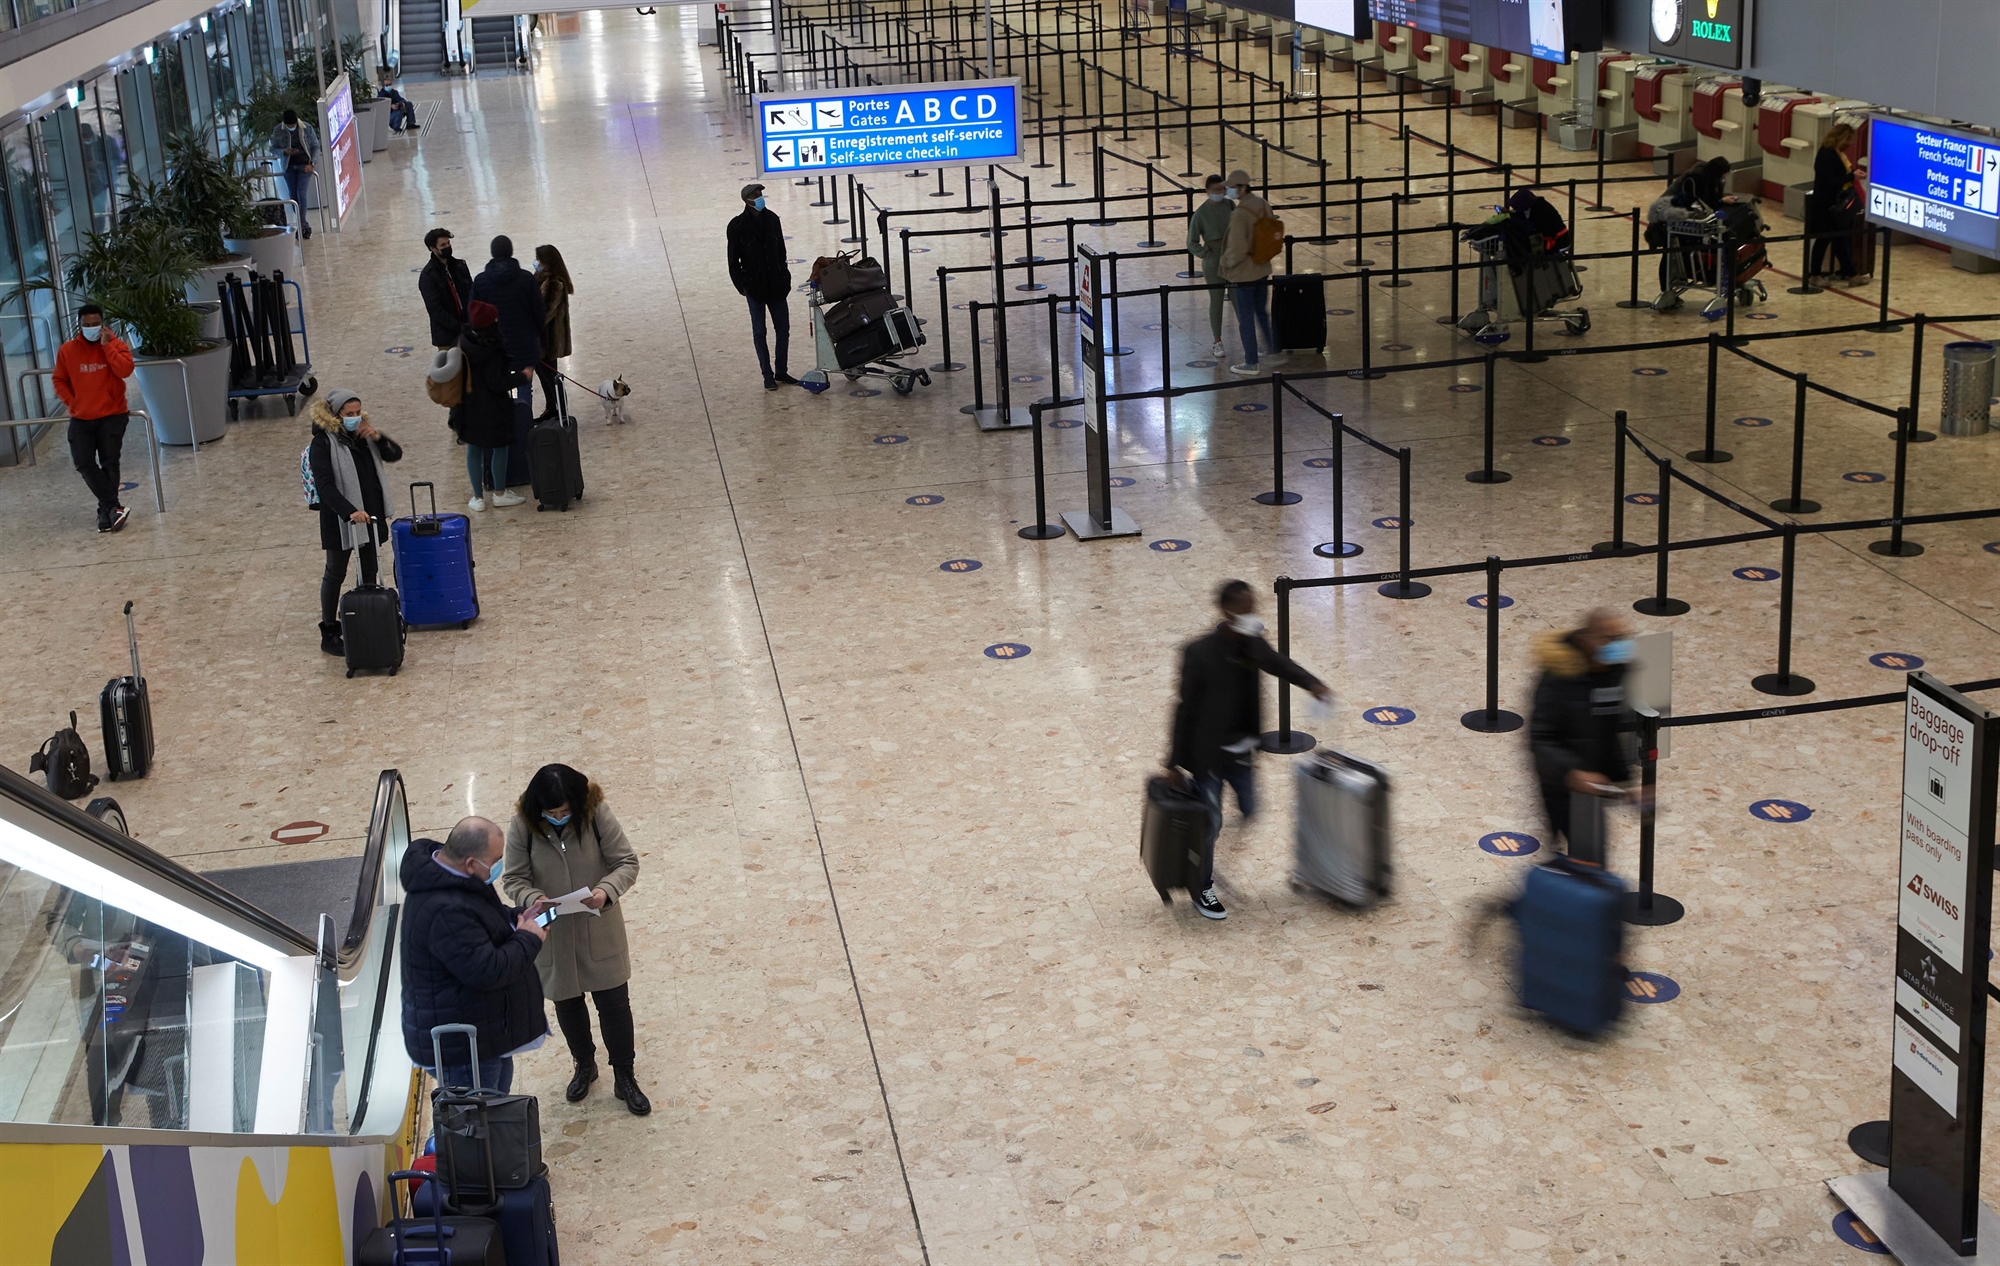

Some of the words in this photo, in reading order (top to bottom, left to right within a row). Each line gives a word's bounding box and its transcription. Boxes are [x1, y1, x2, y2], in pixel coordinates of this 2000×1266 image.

[1692, 20, 1731, 42] ROLEX
[849, 100, 890, 112] Portes
[895, 100, 915, 124] A
[924, 98, 941, 122] B
[950, 96, 968, 121] C
[977, 94, 997, 119] D
[850, 115, 887, 127] Gates
[830, 132, 928, 150] Enregistrement
[931, 128, 1003, 143] self-service
[1916, 132, 1942, 148] Secteur
[1943, 138, 1967, 154] France
[830, 148, 903, 164] Self-service
[906, 146, 958, 159] check-in
[1918, 147, 1942, 162] French
[1943, 153, 1966, 168] Sector
[1927, 169, 1949, 184] Portes
[1928, 184, 1948, 199] Gates
[1953, 178, 1962, 201] F
[1924, 202, 1955, 220] Toilettes
[1924, 216, 1947, 233] Toilets
[1911, 695, 1964, 744] Baggage
[1909, 722, 1961, 766] drop-off
[1906, 811, 1925, 833] With
[1926, 824, 1961, 861] boarding
[1906, 829, 1924, 848] pass
[1925, 843, 1942, 862] only
[1923, 884, 1959, 921] SWISS
[1902, 968, 1920, 988] STAR
[1920, 984, 1955, 1016] ALLIANCE
[1916, 1049, 1943, 1076] edelweiss
